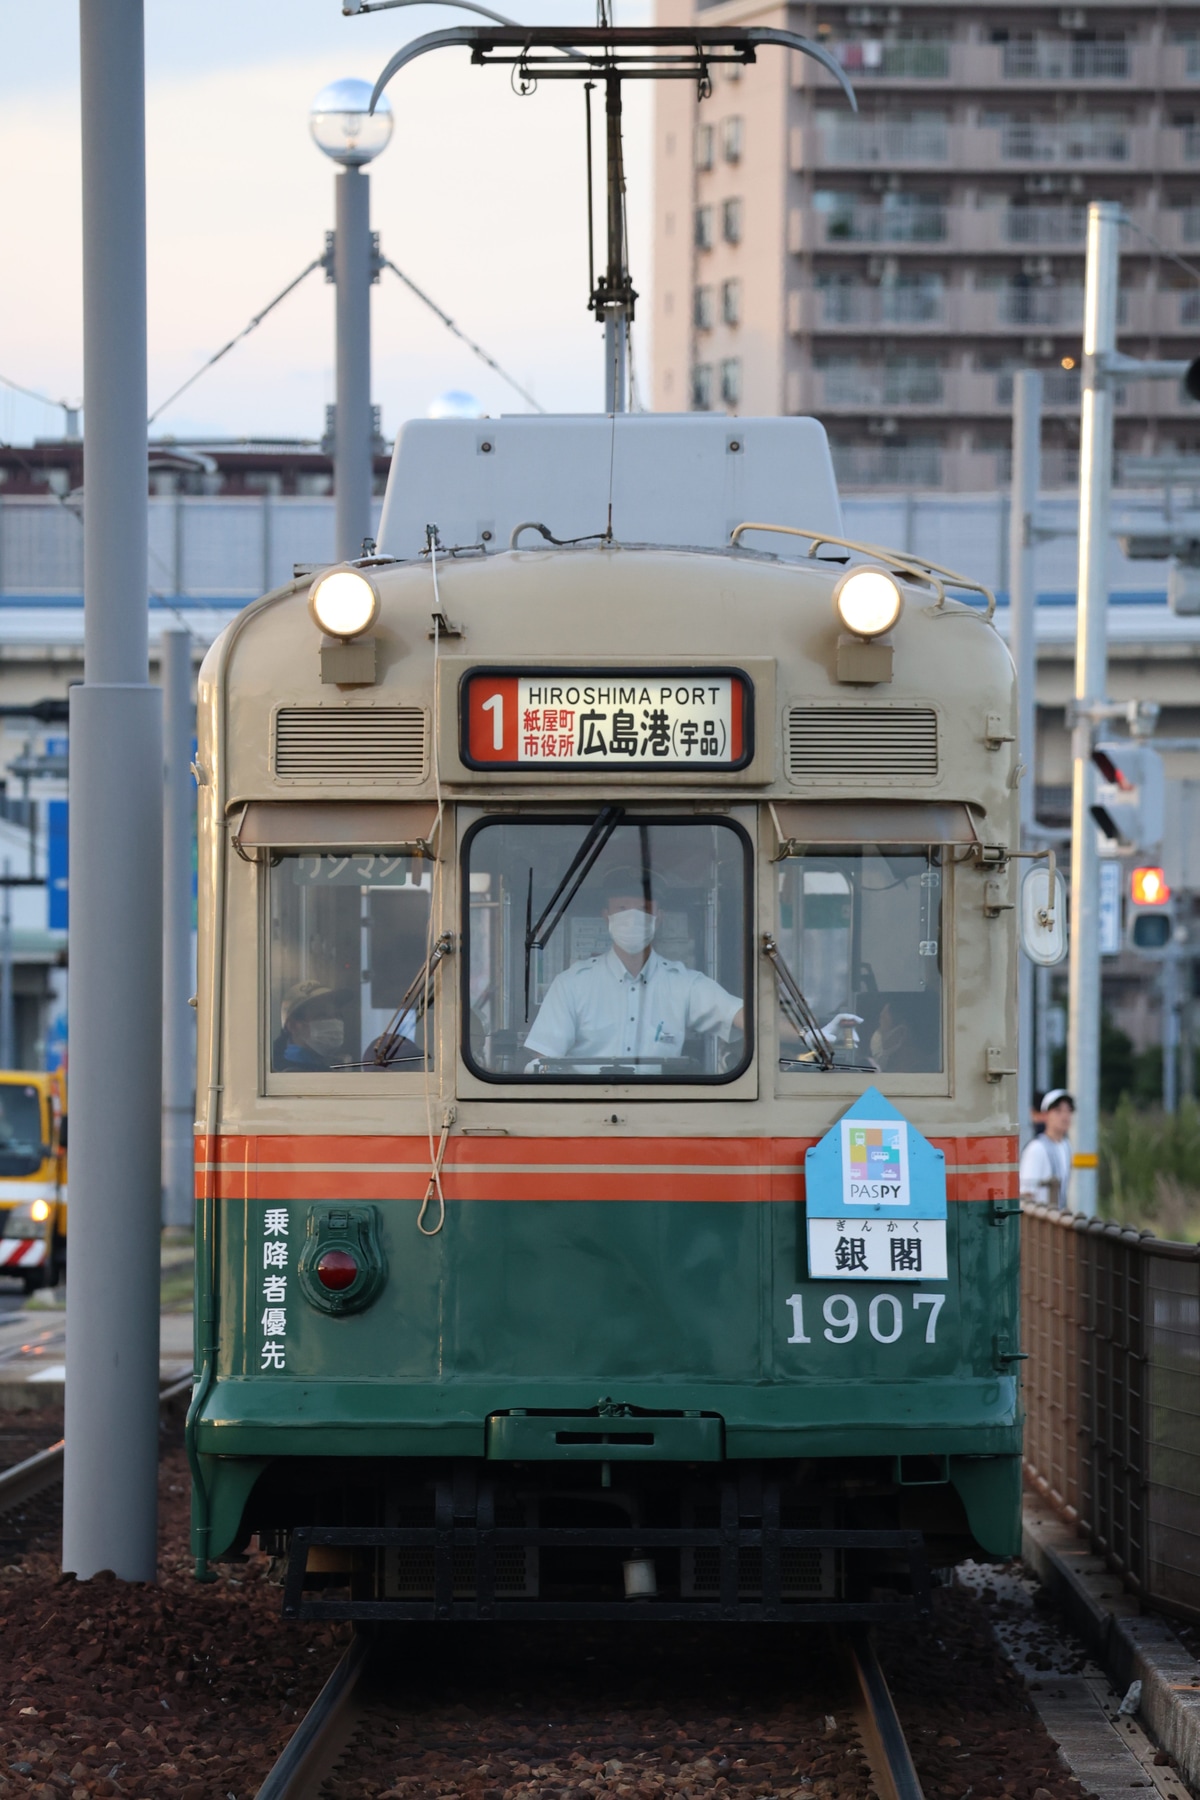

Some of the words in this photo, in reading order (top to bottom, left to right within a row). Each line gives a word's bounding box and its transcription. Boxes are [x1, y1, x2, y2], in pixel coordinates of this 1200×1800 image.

[529, 687, 652, 705] HIROSHIMA
[660, 687, 720, 705] PORT
[482, 693, 504, 751] 1
[523, 709, 576, 732] 紙屋町
[577, 709, 726, 757] 広島港(宇品)
[523, 733, 575, 757] 市役所
[298, 853, 402, 879] ワンマン
[850, 1184, 901, 1199] PASPY
[836, 1219, 920, 1233] ぎんかく
[834, 1236, 923, 1272] 銀閣
[261, 1208, 289, 1370] 乗降者優先
[785, 1293, 946, 1344] 1907
